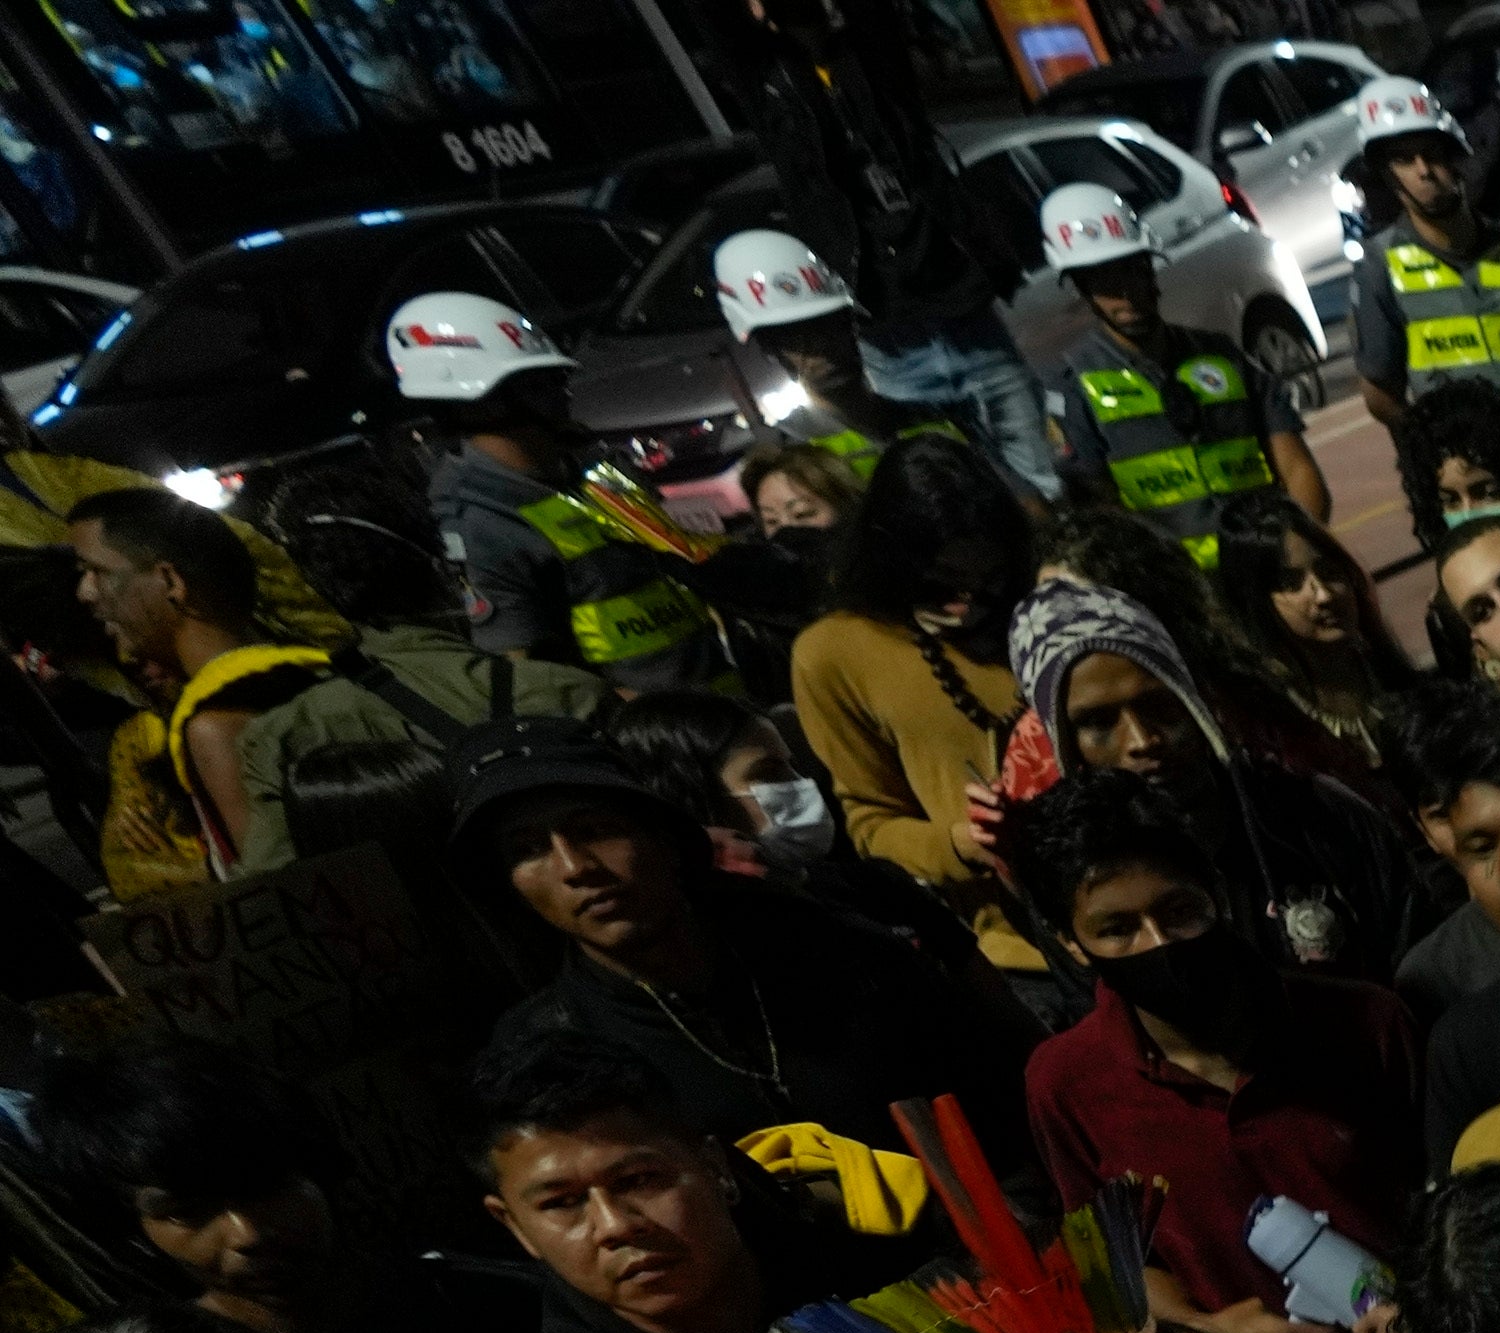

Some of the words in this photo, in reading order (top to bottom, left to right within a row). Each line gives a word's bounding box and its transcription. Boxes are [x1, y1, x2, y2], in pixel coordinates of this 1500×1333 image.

[1367, 100, 1379, 123] P
[1411, 96, 1430, 117] M
[441, 130, 478, 174] 8
[471, 119, 553, 168] 1604
[1058, 224, 1073, 249] P
[1104, 215, 1124, 238] M
[746, 279, 765, 305] P
[124, 872, 355, 969] QUEM
